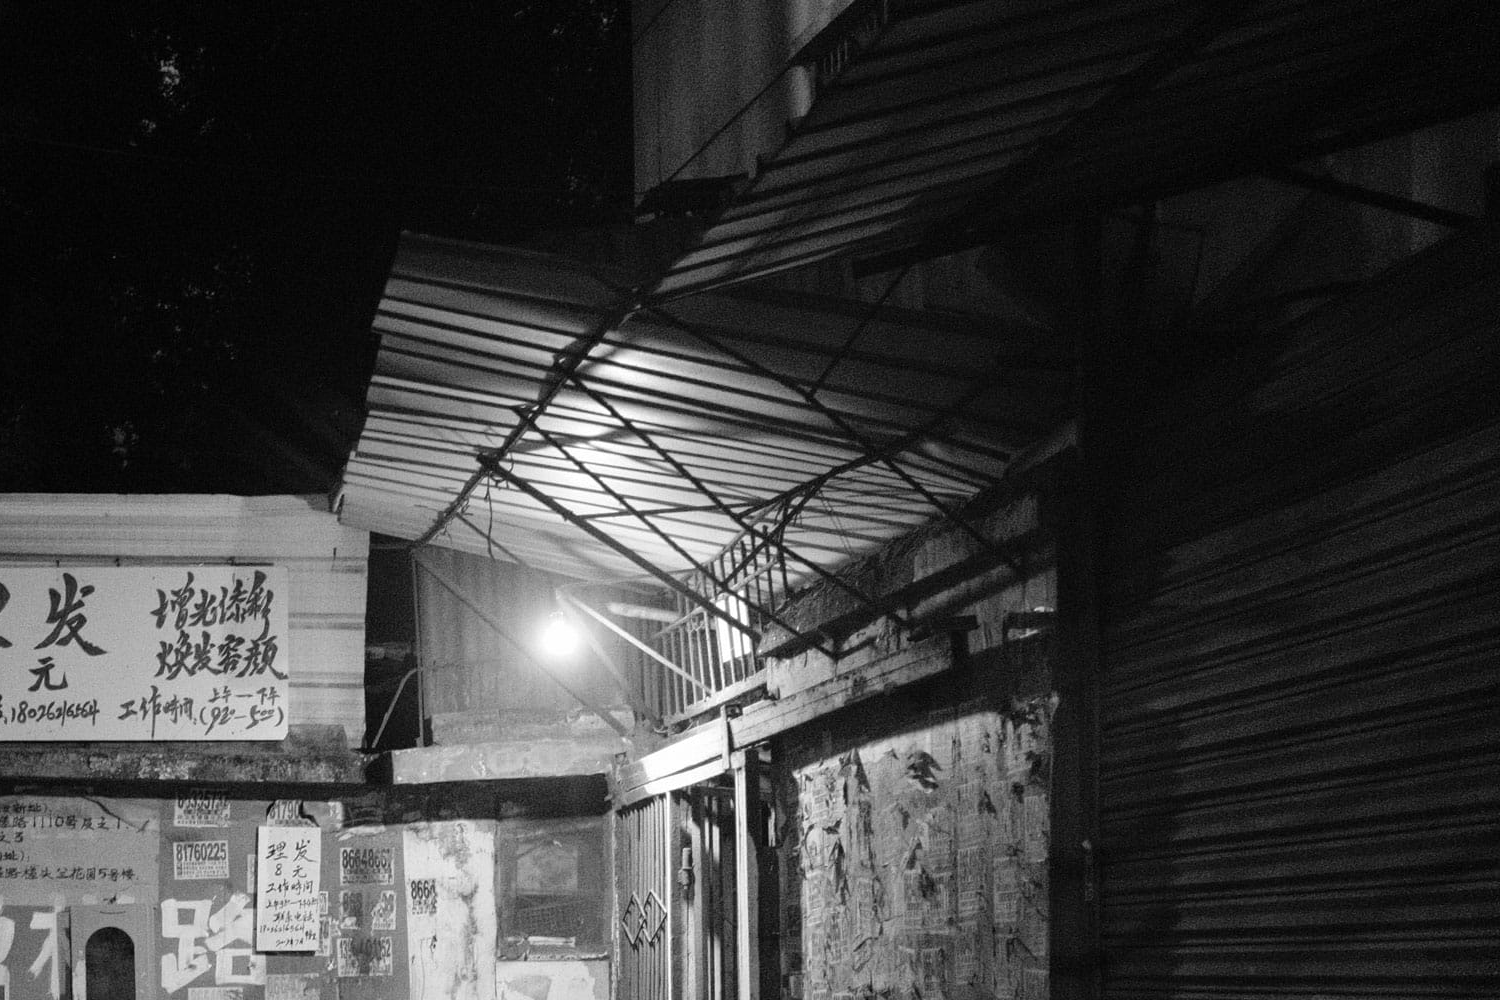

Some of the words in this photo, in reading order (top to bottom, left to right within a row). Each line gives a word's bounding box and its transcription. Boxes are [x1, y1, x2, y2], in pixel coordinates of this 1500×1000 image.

[154, 629, 289, 681] 焕发容颜
[175, 841, 227, 862] 81760225
[265, 838, 317, 863] 理发
[274, 863, 307, 879] 8元
